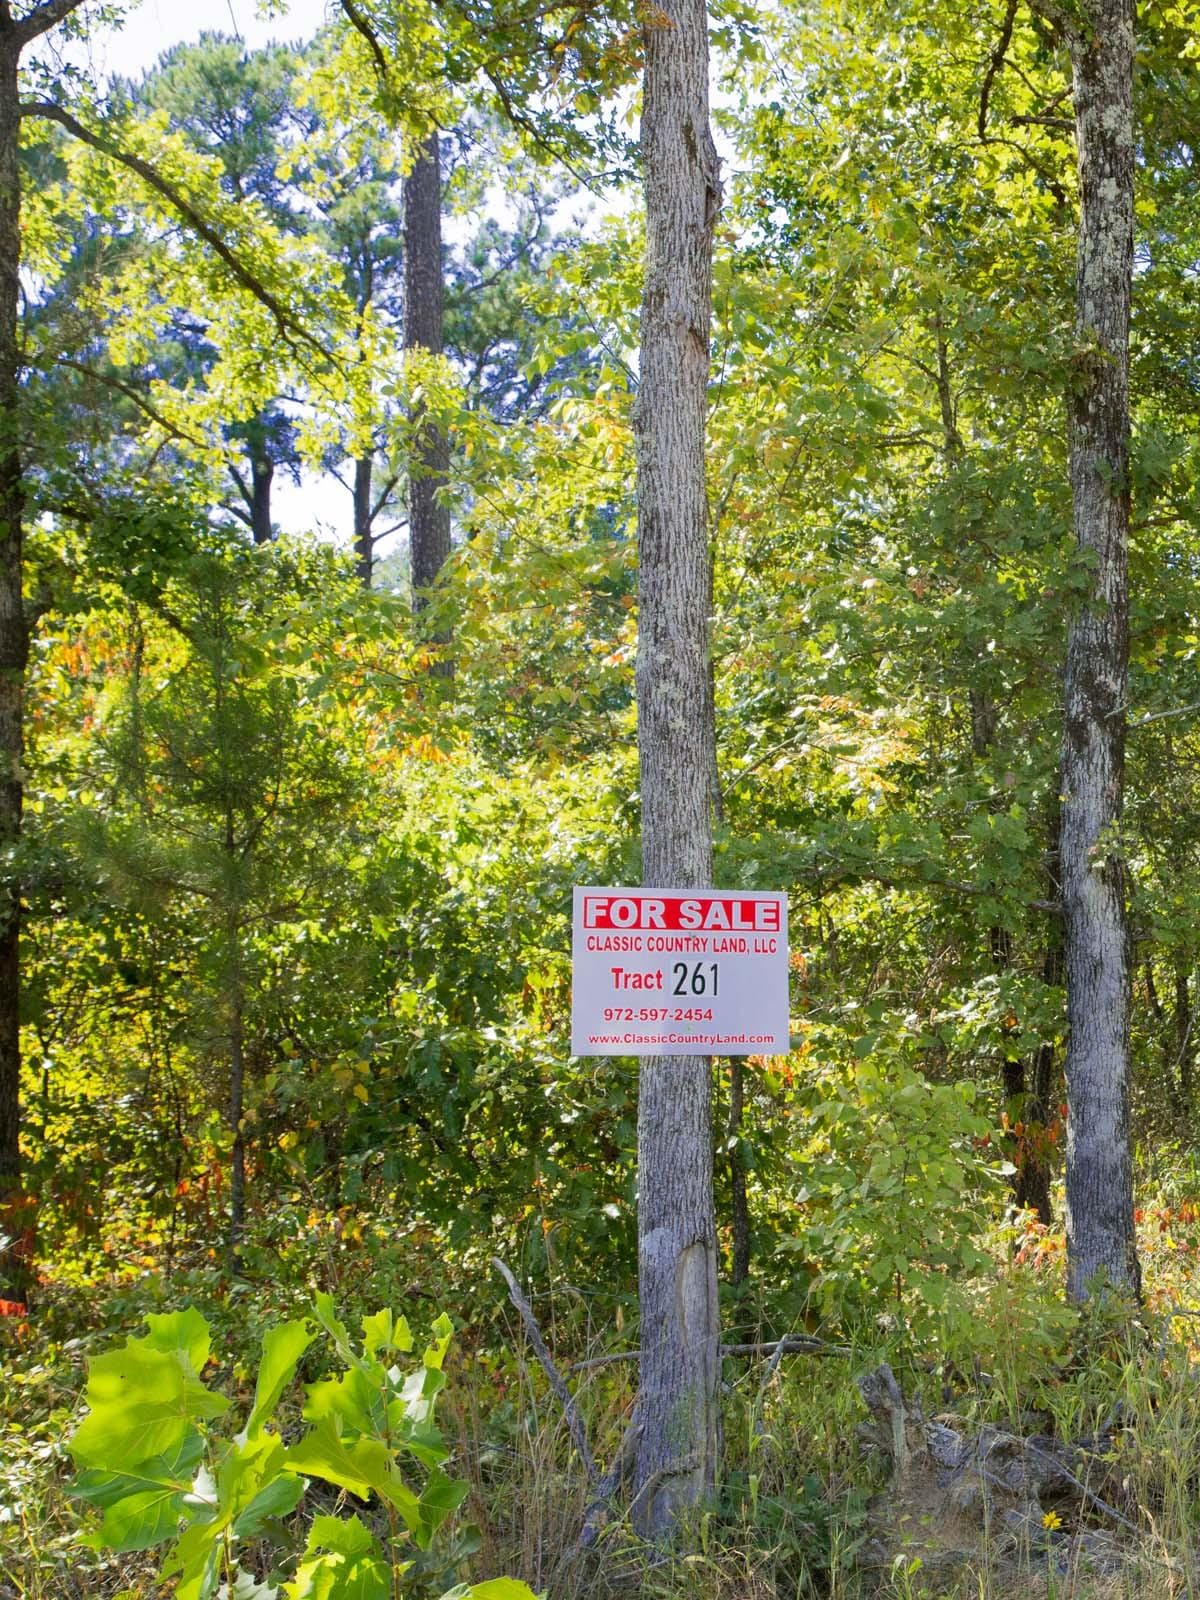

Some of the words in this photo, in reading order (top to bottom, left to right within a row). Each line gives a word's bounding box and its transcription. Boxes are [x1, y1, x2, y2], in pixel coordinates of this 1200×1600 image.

[586, 898, 666, 929] FOR
[678, 900, 778, 930] SALE
[587, 936, 642, 951] CLASSIC
[647, 937, 708, 952] COUNTRY
[713, 938, 750, 954] LAND,
[754, 939, 776, 953] LLC
[611, 968, 663, 989] Tract
[673, 962, 718, 996] 261
[604, 1008, 712, 1021] 972-597-2454
[589, 1034, 774, 1046] www.ClassicCountryLand.com
